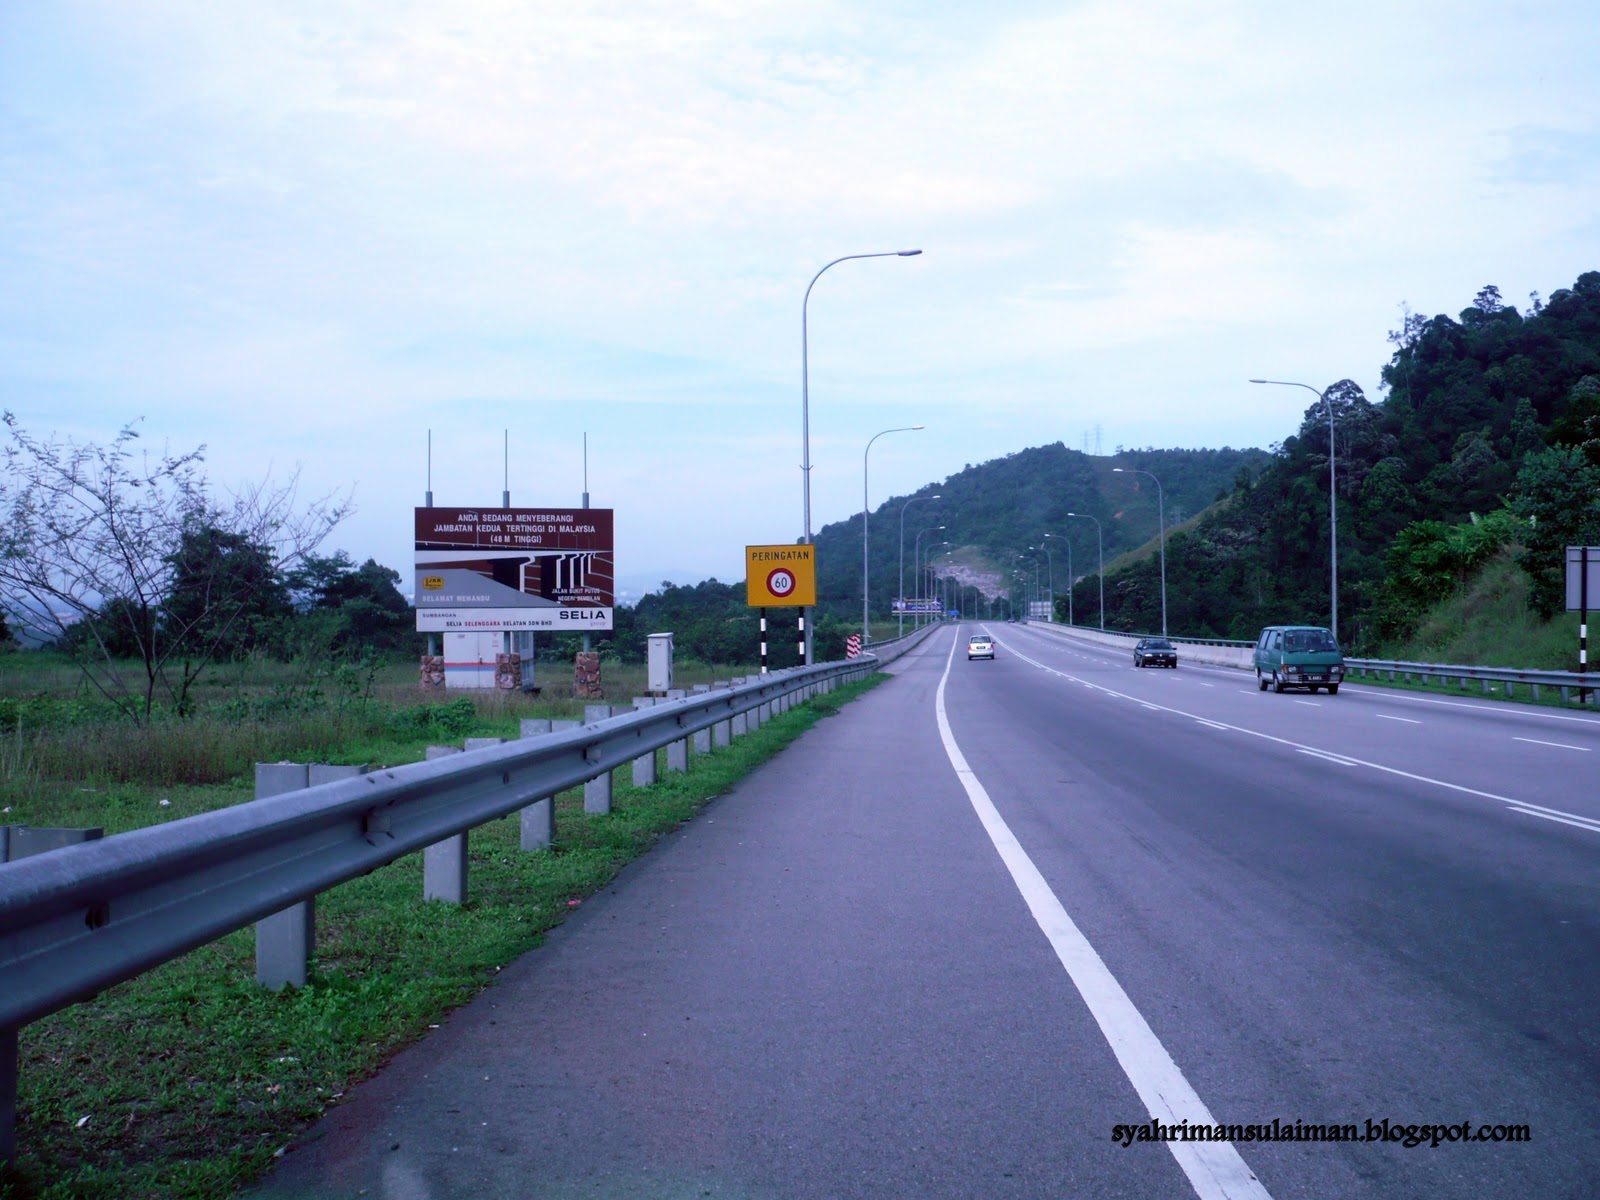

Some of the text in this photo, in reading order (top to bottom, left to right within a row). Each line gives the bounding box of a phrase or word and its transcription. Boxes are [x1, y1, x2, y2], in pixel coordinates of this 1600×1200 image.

[458, 514, 574, 523] ANDA SEDANG MENYEBERANGI
[434, 524, 596, 533] JAMBATAN KEDUA TERTINGGI DI MALAYSIA
[504, 535, 511, 543] M
[514, 535, 542, 544] TINGGI)
[752, 551, 809, 561] PERINGATAN
[775, 577, 788, 588] 60
[559, 610, 606, 620] SELIA
